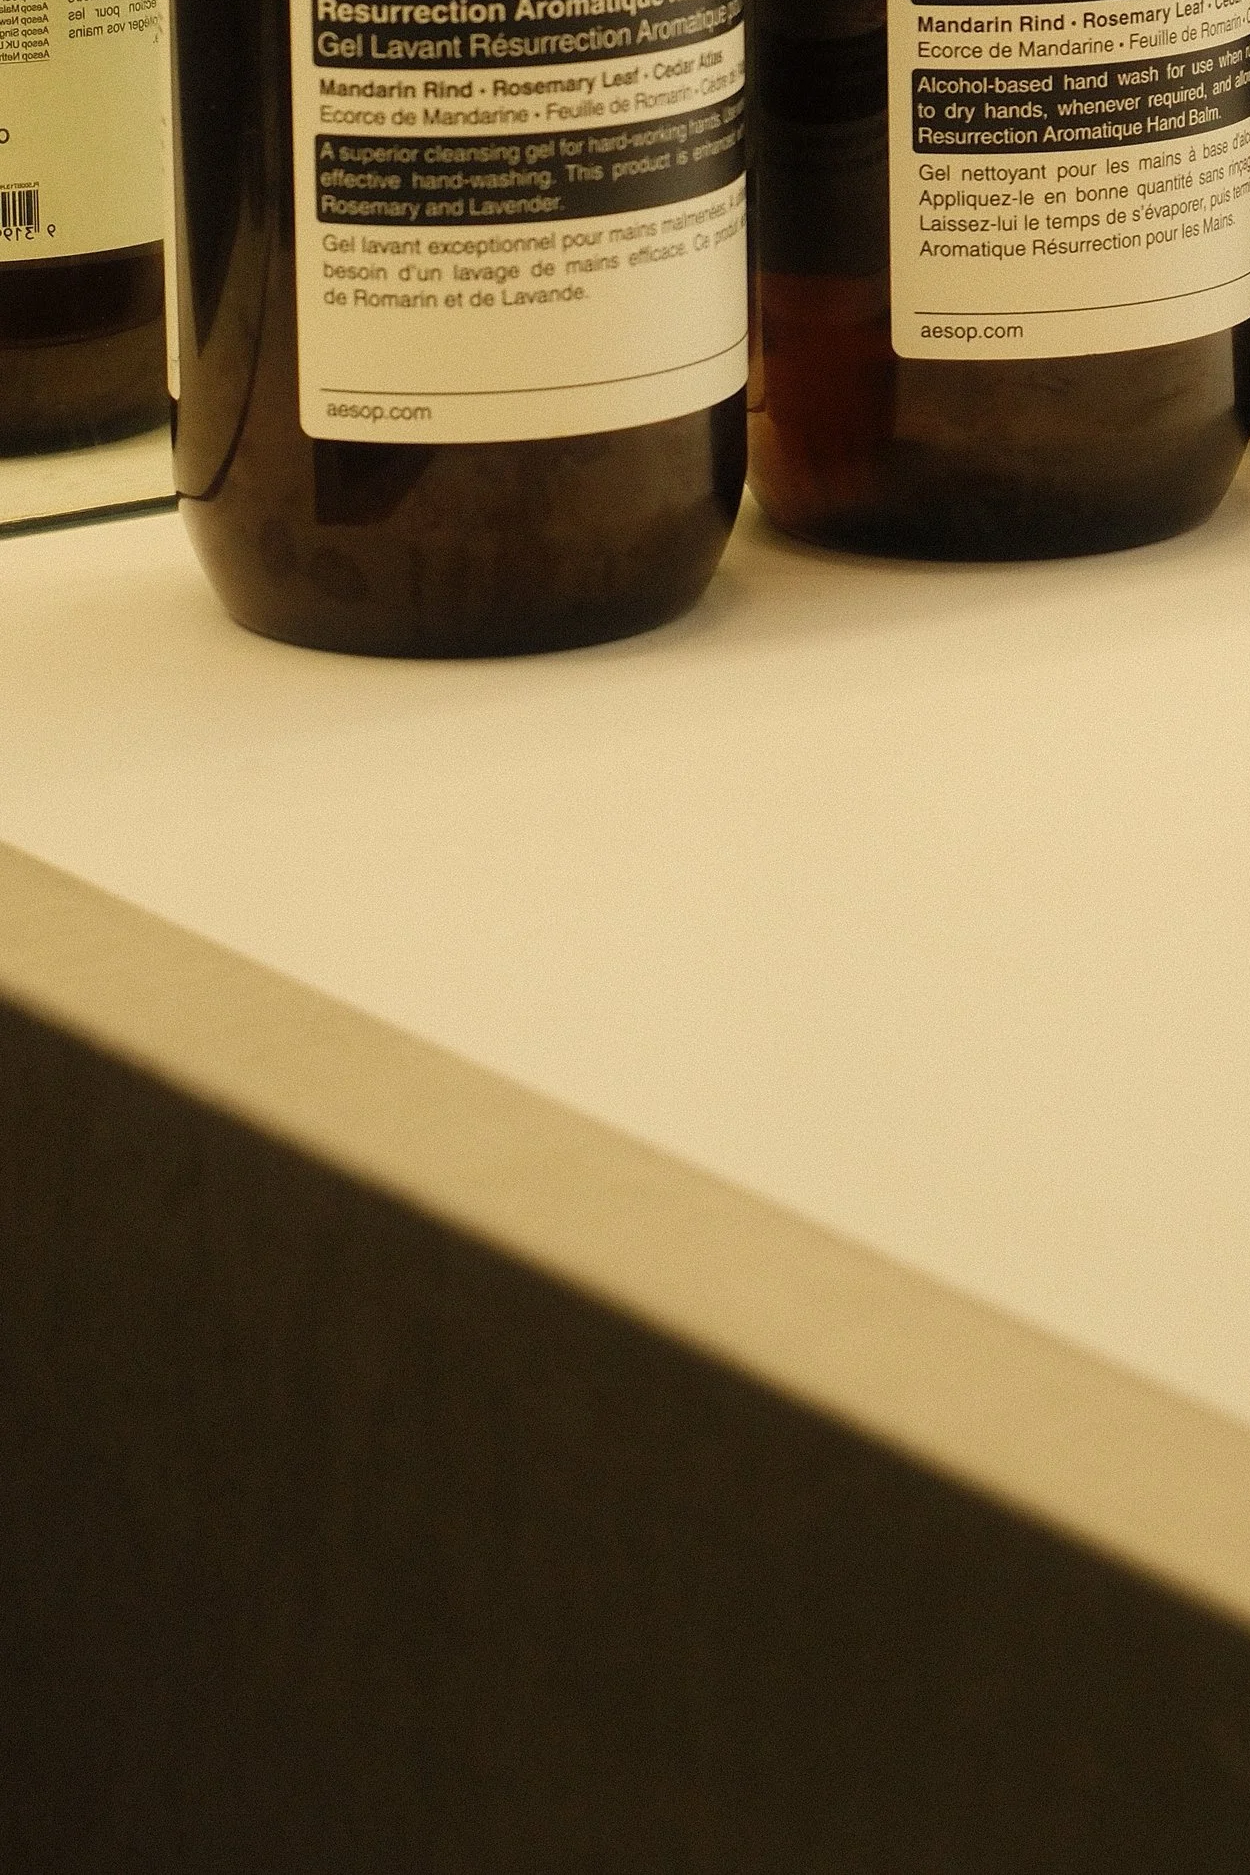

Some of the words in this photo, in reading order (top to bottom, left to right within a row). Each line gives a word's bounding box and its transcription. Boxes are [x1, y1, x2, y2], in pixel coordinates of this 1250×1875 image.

[316, 31, 364, 58] Gel
[370, 31, 462, 59] Lavant
[469, 20, 631, 57] Résurrection
[637, 5, 727, 44] Aromatique
[918, 15, 1012, 34] Mandarin
[1021, 14, 1064, 31] Rind
[1083, 8, 1170, 30] Rosemary
[918, 42, 982, 58] Ecorce
[989, 40, 1012, 57] de
[1018, 38, 1114, 57] Mandarine
[1130, 27, 1178, 50] Feuille
[1182, 25, 1196, 40] de
[1201, 15, 1241, 36] Romarin
[319, 79, 416, 98] Mandarin
[424, 79, 472, 97] Rind
[493, 75, 596, 98] Rosemary
[602, 67, 639, 87] Leaf
[918, 76, 1053, 94] Alcohol-based
[1064, 75, 1108, 91] hand
[1117, 71, 1159, 89] wash
[1167, 63, 1185, 80] for
[1192, 59, 1213, 75] use
[1219, 51, 1242, 68] when
[320, 106, 386, 124] Ecorce
[392, 106, 416, 125] de
[422, 106, 529, 125] Mandarine
[918, 103, 936, 120] to
[945, 101, 976, 124] dry
[985, 101, 1049, 121] hands,
[1057, 95, 1141, 118] whenever
[1148, 83, 1207, 109] required,
[1213, 78, 1231, 96] and
[918, 127, 1043, 146] Resurrection
[1043, 123, 1144, 143] Aromatique
[1147, 116, 1186, 133] Hand
[1189, 108, 1222, 126] Balm.
[320, 143, 334, 160] A
[340, 143, 418, 166] superior
[424, 143, 521, 167] cleansing
[525, 140, 554, 164] gel
[560, 139, 585, 158] for
[321, 169, 401, 189] effective
[566, 164, 604, 182] This
[612, 153, 671, 182] product
[919, 164, 951, 182] Gel
[961, 165, 1047, 187] nettoyant
[1057, 166, 1096, 184] pour
[1107, 157, 1129, 175] les
[1139, 153, 1182, 172] mains
[1189, 146, 1196, 162] à
[1203, 143, 1229, 159] base
[322, 195, 420, 220] Rosemary
[425, 197, 463, 216] and
[469, 195, 564, 216] Lavender.
[919, 189, 1034, 212] Appliquez-le
[1045, 191, 1066, 206] en
[1076, 184, 1129, 203] bonne
[1137, 175, 1193, 199] quantité
[1199, 167, 1224, 185] sans
[919, 214, 1017, 233] Laissez-lui
[1024, 213, 1039, 231] le
[1047, 212, 1100, 233] temps
[1106, 206, 1127, 225] de
[1133, 198, 1207, 224] s'évaporer,
[1210, 189, 1231, 209] puis
[322, 235, 355, 254] Gel
[361, 234, 421, 254] lavant
[428, 233, 557, 258] exceptionnel
[562, 228, 602, 253] pour
[609, 222, 657, 241] mains
[919, 239, 1026, 260] Aromatique
[1033, 232, 1142, 256] Résurrection
[1146, 229, 1179, 249] pour
[1182, 224, 1200, 239] les
[1203, 214, 1236, 234] Mains.
[323, 261, 387, 280] besoin
[454, 262, 519, 285] lavage
[531, 257, 555, 277] de
[566, 250, 618, 275] mains
[324, 289, 347, 306] de
[354, 289, 437, 308] Romarin
[444, 289, 464, 308] et
[470, 288, 494, 307] de
[502, 285, 590, 307] Lavande.
[921, 322, 1024, 342] aesop.com
[327, 401, 431, 422] aesop.com
